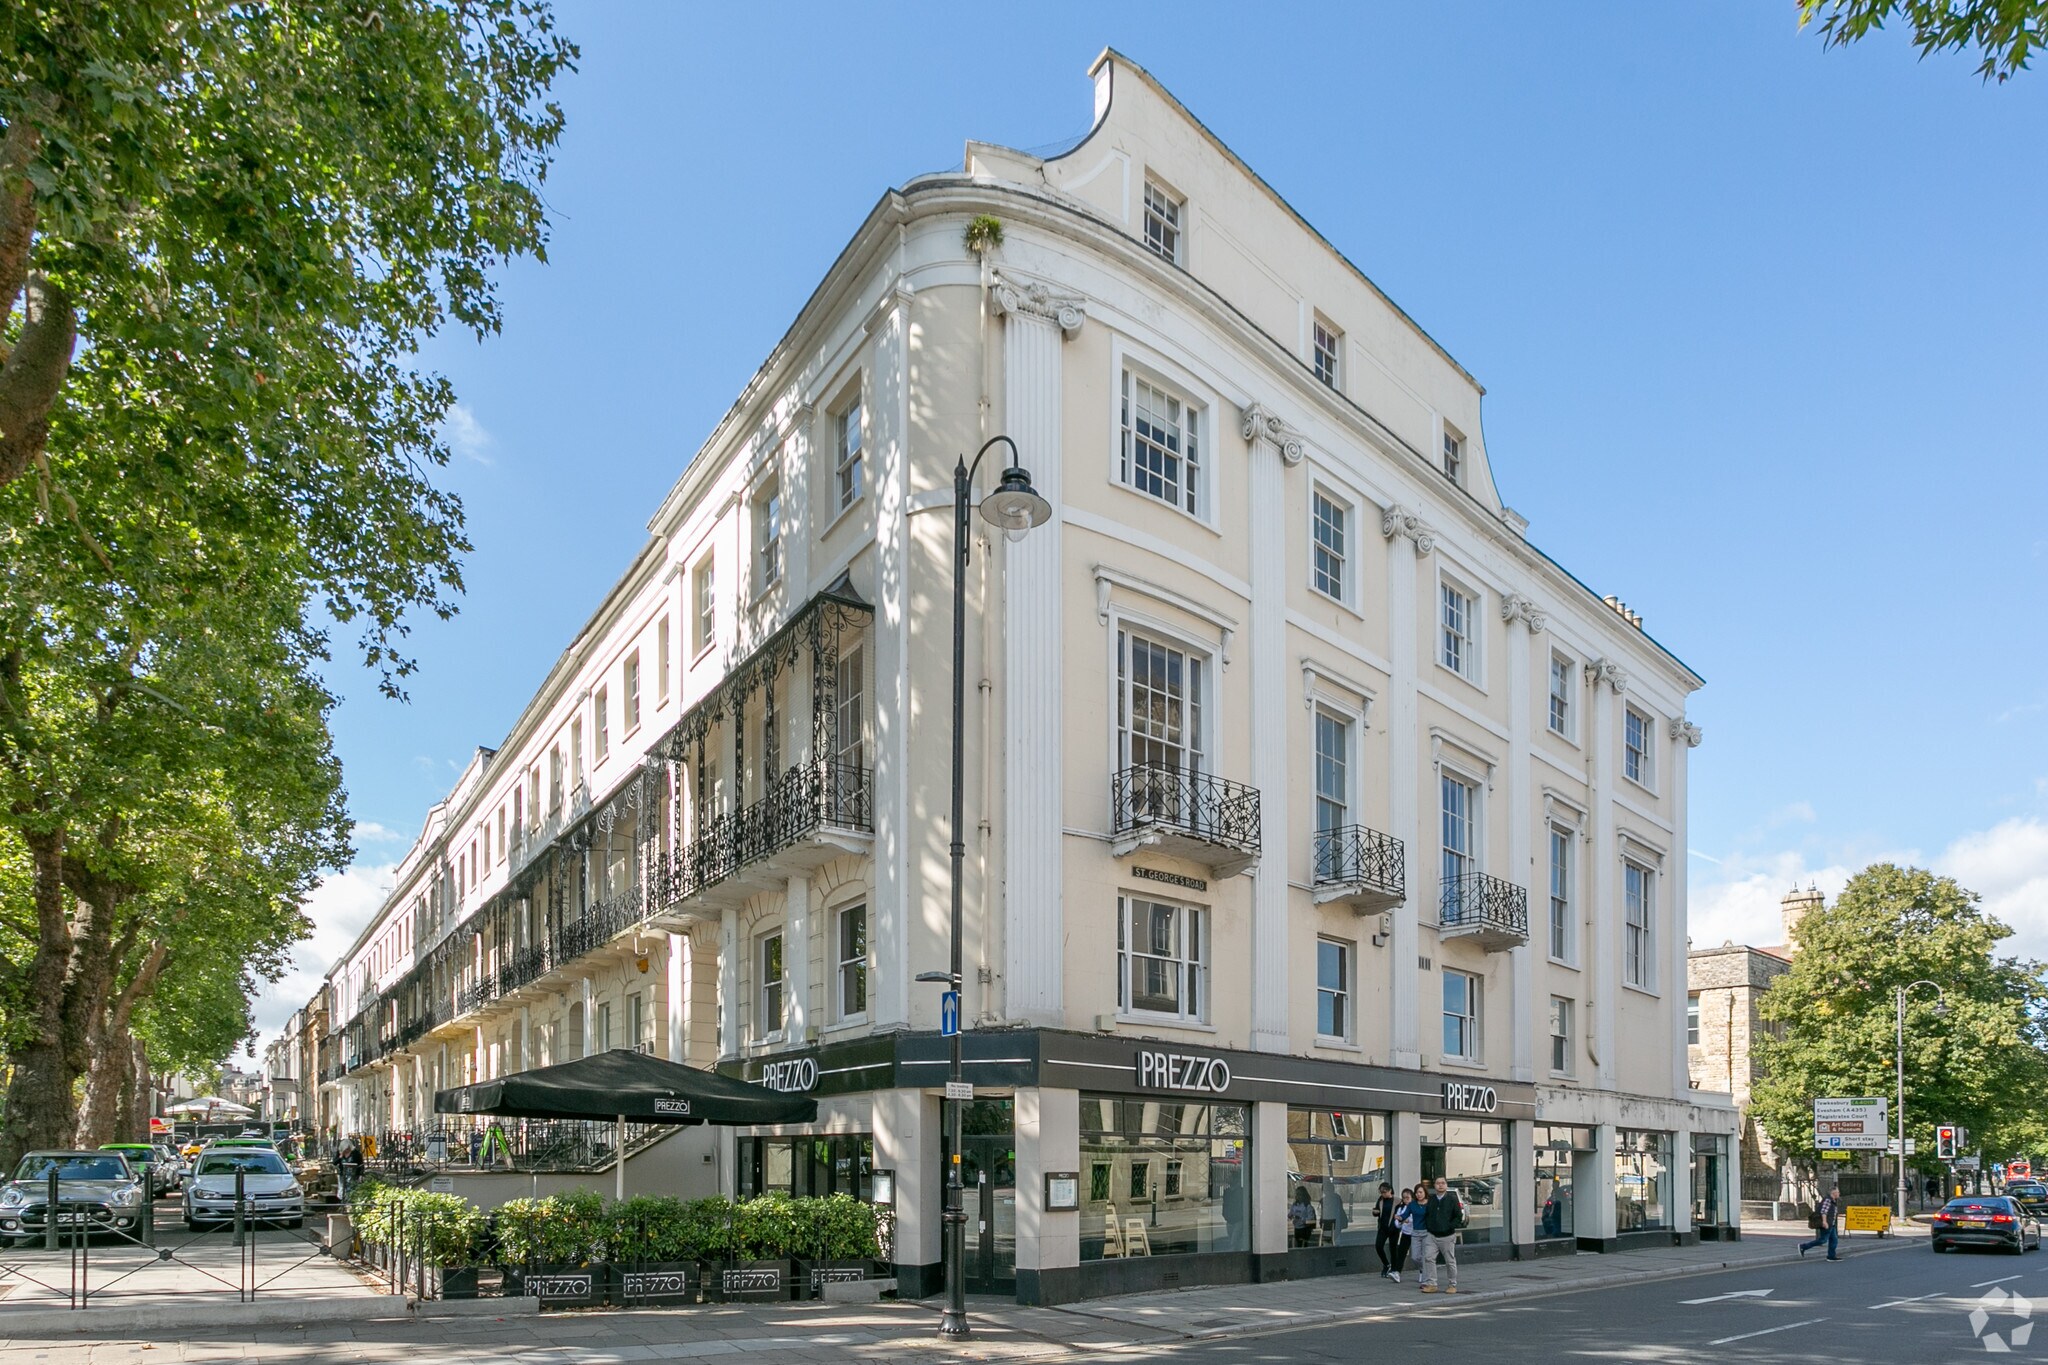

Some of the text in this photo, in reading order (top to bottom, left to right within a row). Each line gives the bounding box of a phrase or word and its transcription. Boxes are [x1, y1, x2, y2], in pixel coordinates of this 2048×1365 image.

[1135, 868, 1204, 890] ST. GEORGE'S ROAD
[763, 1058, 817, 1092] PREZZO
[1139, 1050, 1230, 1093] PREZZO
[656, 1101, 688, 1112] PREZZO
[1447, 1082, 1497, 1113] PREZZO
